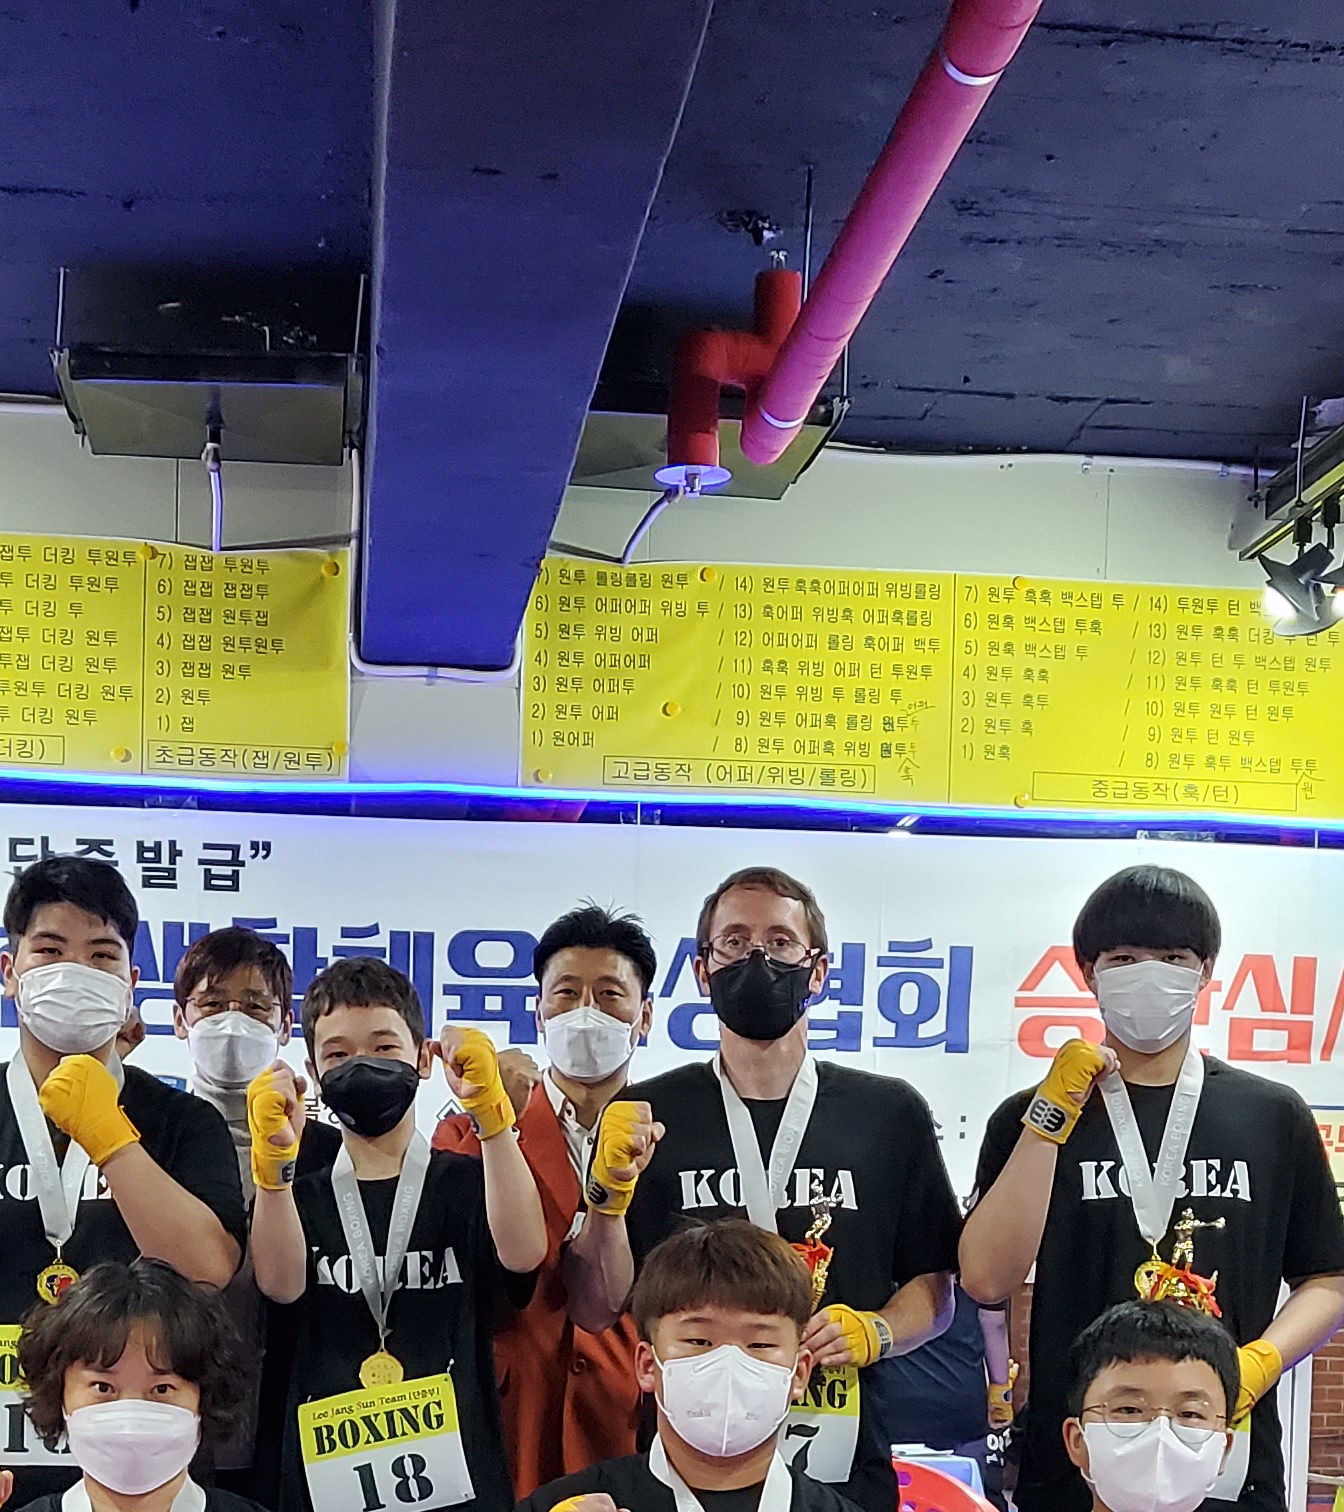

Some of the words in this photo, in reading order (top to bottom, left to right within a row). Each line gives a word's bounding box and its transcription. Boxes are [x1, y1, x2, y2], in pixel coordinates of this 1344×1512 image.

[44, 547, 75, 564] 더킹
[88, 549, 137, 567] 투원투
[158, 579, 172, 595] 6)
[183, 580, 213, 597] 잽잽
[224, 582, 270, 599] 잽잽투
[157, 633, 171, 649] 4)
[182, 634, 212, 651] 잽잽
[222, 636, 285, 654] 원투원투
[735, 631, 753, 648] 12)
[762, 632, 818, 650] 어퍼어퍼
[914, 637, 940, 653] 백투
[156, 745, 333, 771] 초급동작(잽/원투)
[612, 760, 692, 782] 고급동작
[356, 1399, 376, 1411] Sun
[377, 1394, 407, 1406] Team
[312, 1399, 445, 1456] BOXING
[353, 1453, 434, 1512] 18
